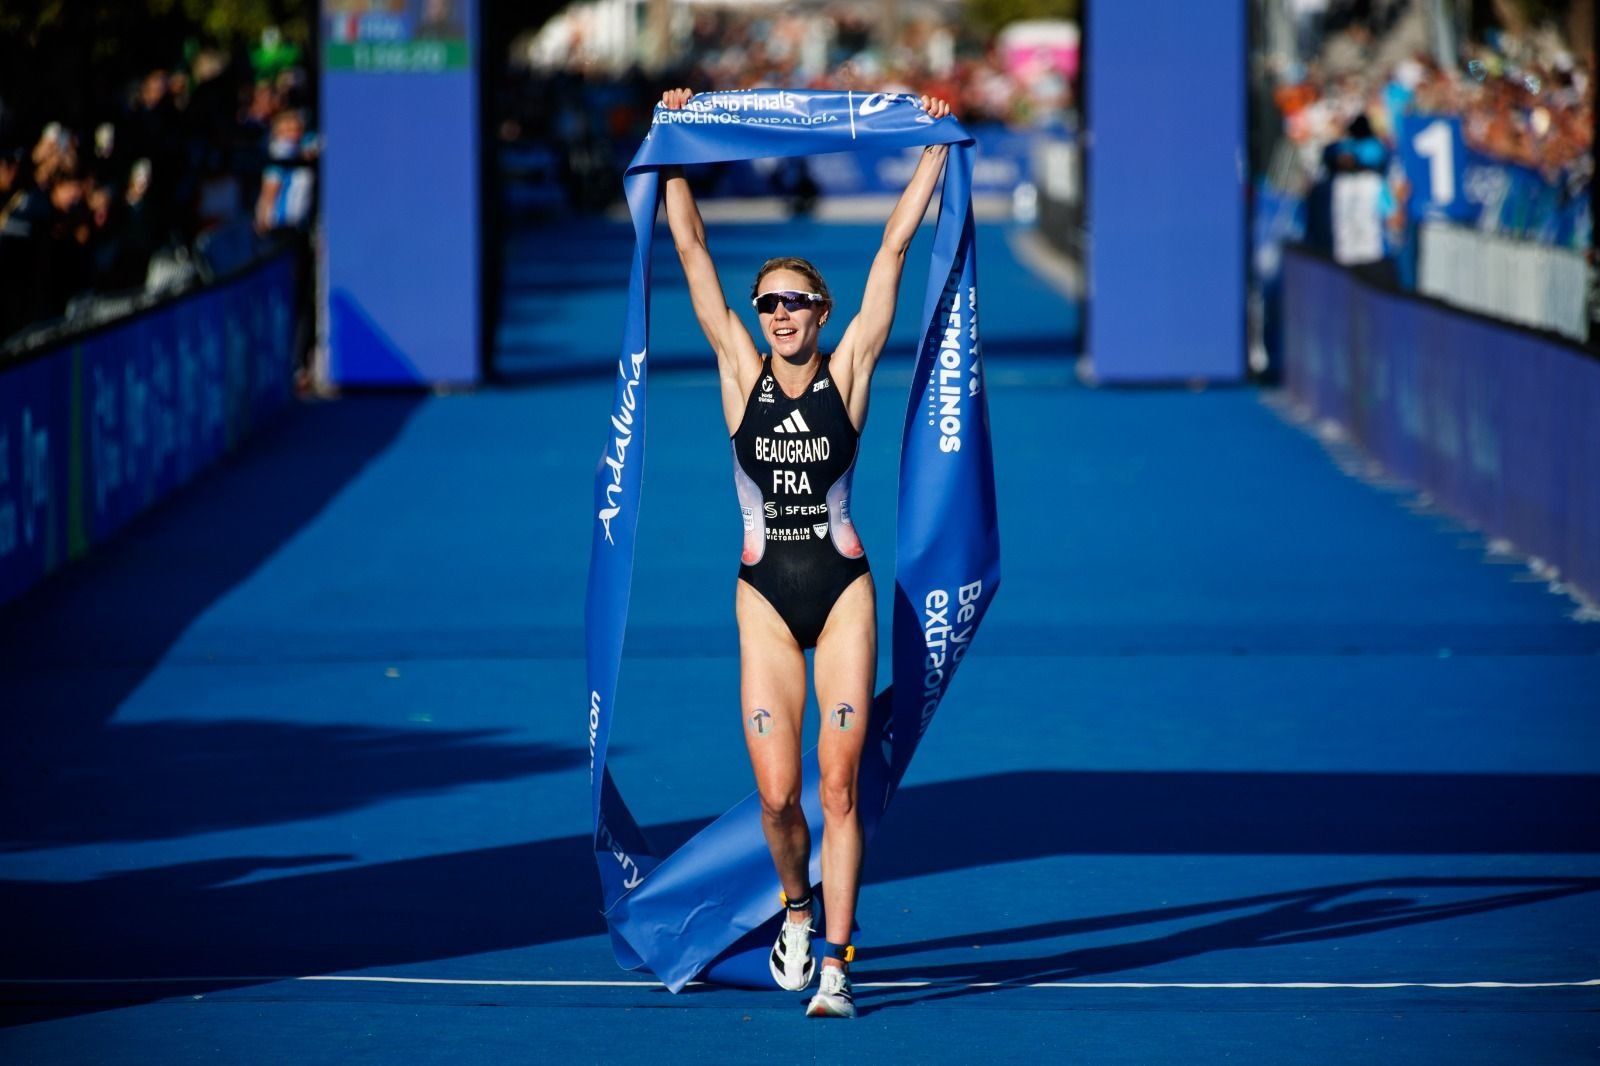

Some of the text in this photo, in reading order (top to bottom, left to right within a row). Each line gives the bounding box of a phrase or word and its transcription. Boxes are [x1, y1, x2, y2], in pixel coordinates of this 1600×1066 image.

[743, 91, 794, 111] Finals
[1412, 119, 1455, 205] 1
[598, 347, 647, 546] Andalucía
[755, 437, 830, 463] BEAUGRAND
[773, 470, 812, 495] FRA
[765, 527, 810, 536] BAHRAIN
[958, 579, 982, 624] Be
